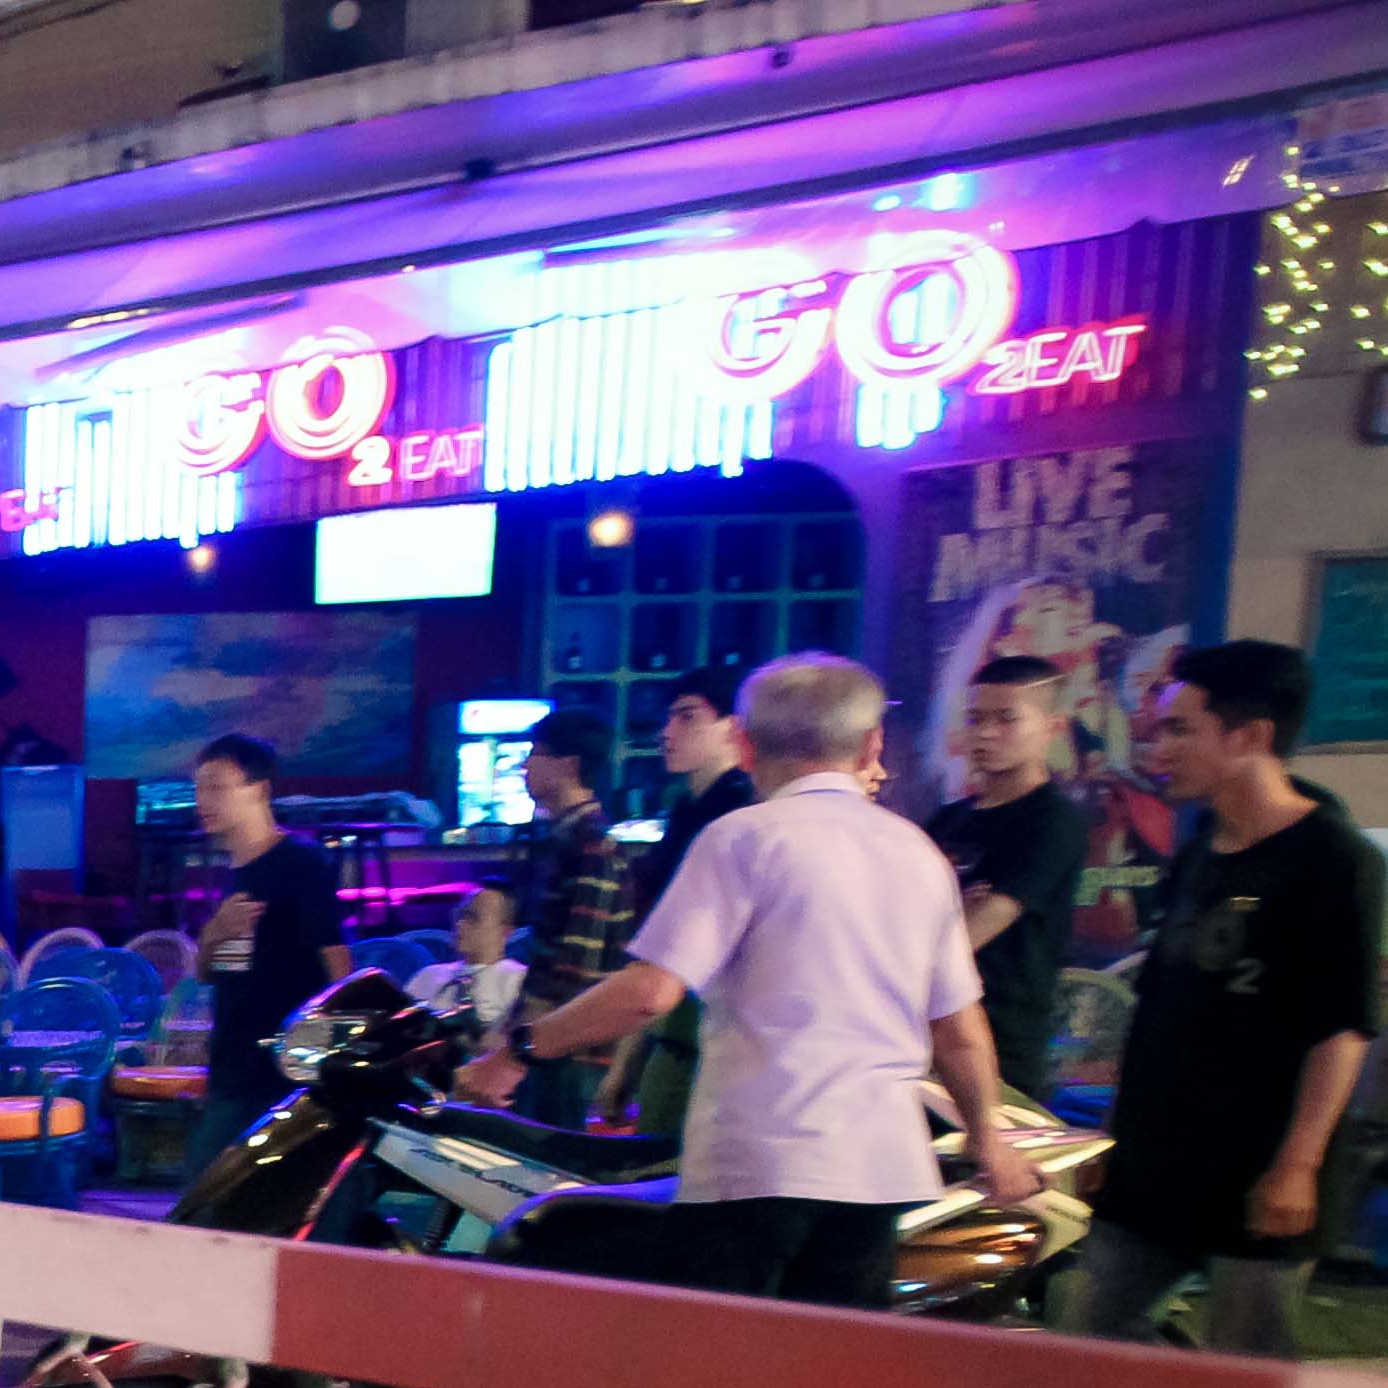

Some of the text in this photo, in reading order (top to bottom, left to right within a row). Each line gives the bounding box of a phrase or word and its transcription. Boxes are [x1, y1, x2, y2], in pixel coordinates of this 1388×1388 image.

[708, 230, 1019, 398] GO
[173, 326, 397, 477] GO
[975, 446, 1135, 530] LIVE
[927, 512, 1169, 603] MUSIC
